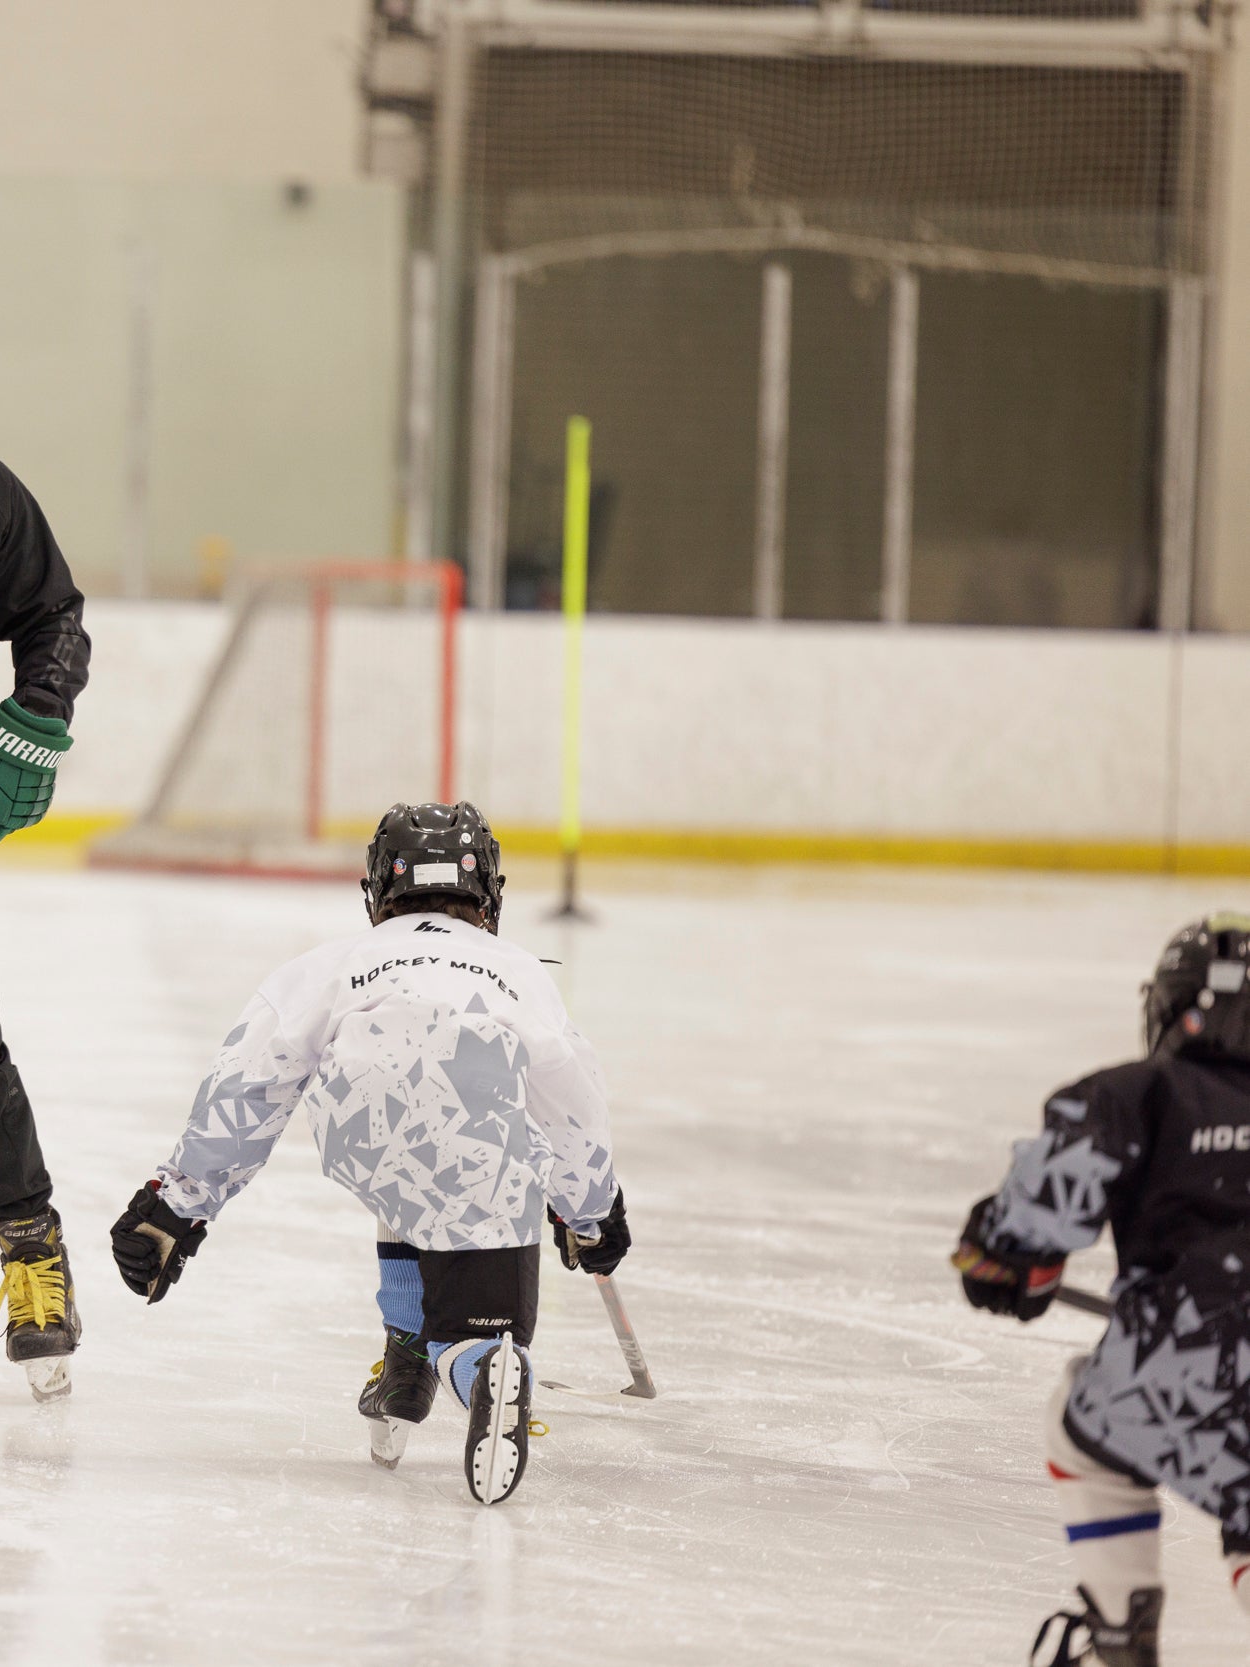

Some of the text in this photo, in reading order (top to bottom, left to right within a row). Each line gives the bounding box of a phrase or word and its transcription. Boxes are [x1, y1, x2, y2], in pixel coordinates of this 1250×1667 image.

[351, 957, 519, 1001] HOCKEY MOVES
[4, 1222, 48, 1237] BAUER
